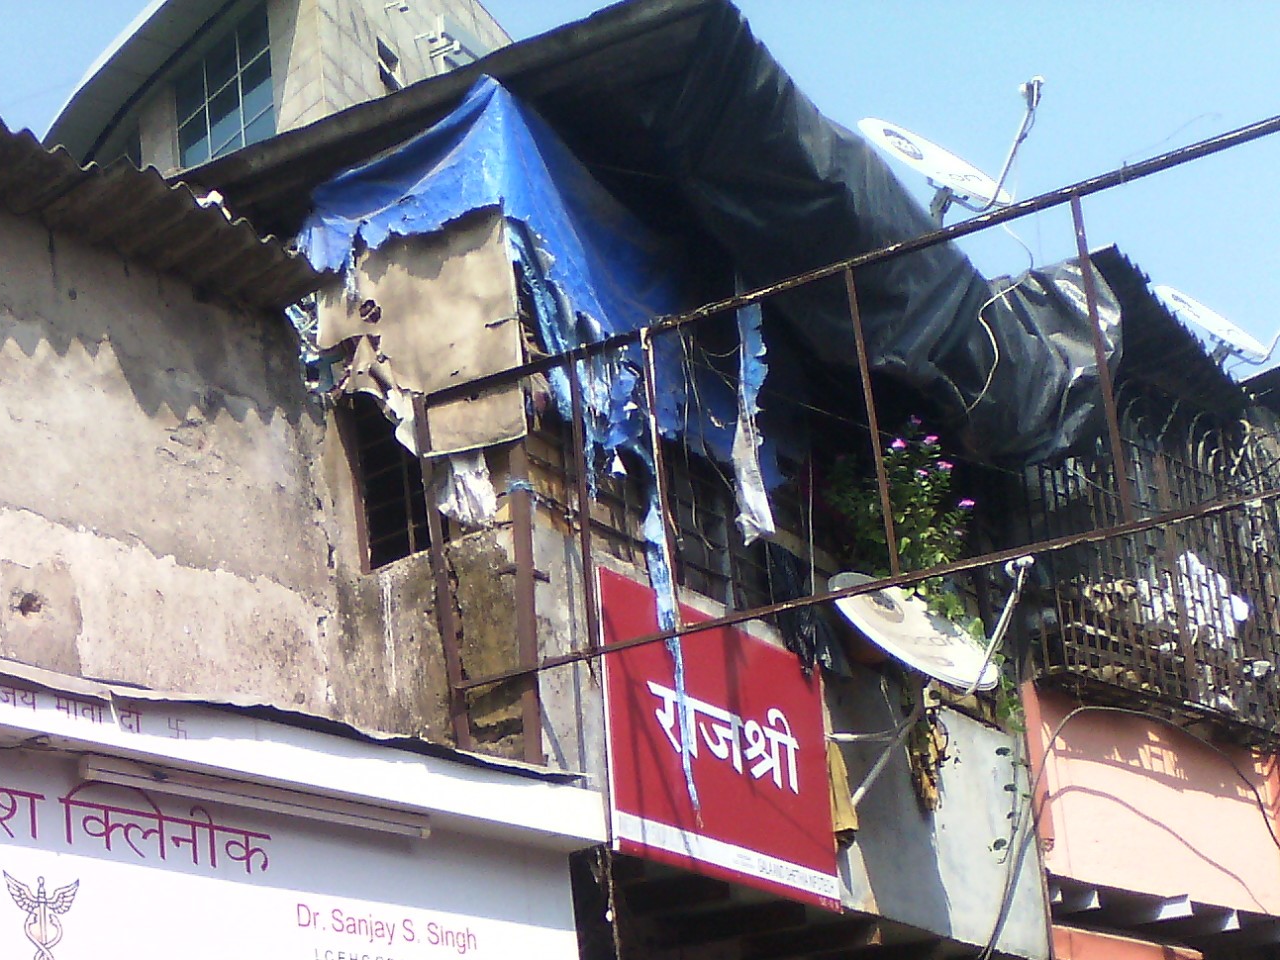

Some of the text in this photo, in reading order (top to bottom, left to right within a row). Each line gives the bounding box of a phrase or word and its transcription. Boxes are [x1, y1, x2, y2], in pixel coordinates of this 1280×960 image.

[54, 693, 105, 725] माता
[646, 680, 800, 794] राजश्री
[58, 780, 272, 874] क्लिनीक
[297, 902, 478, 955] Dr. Sanjay S. Singh
